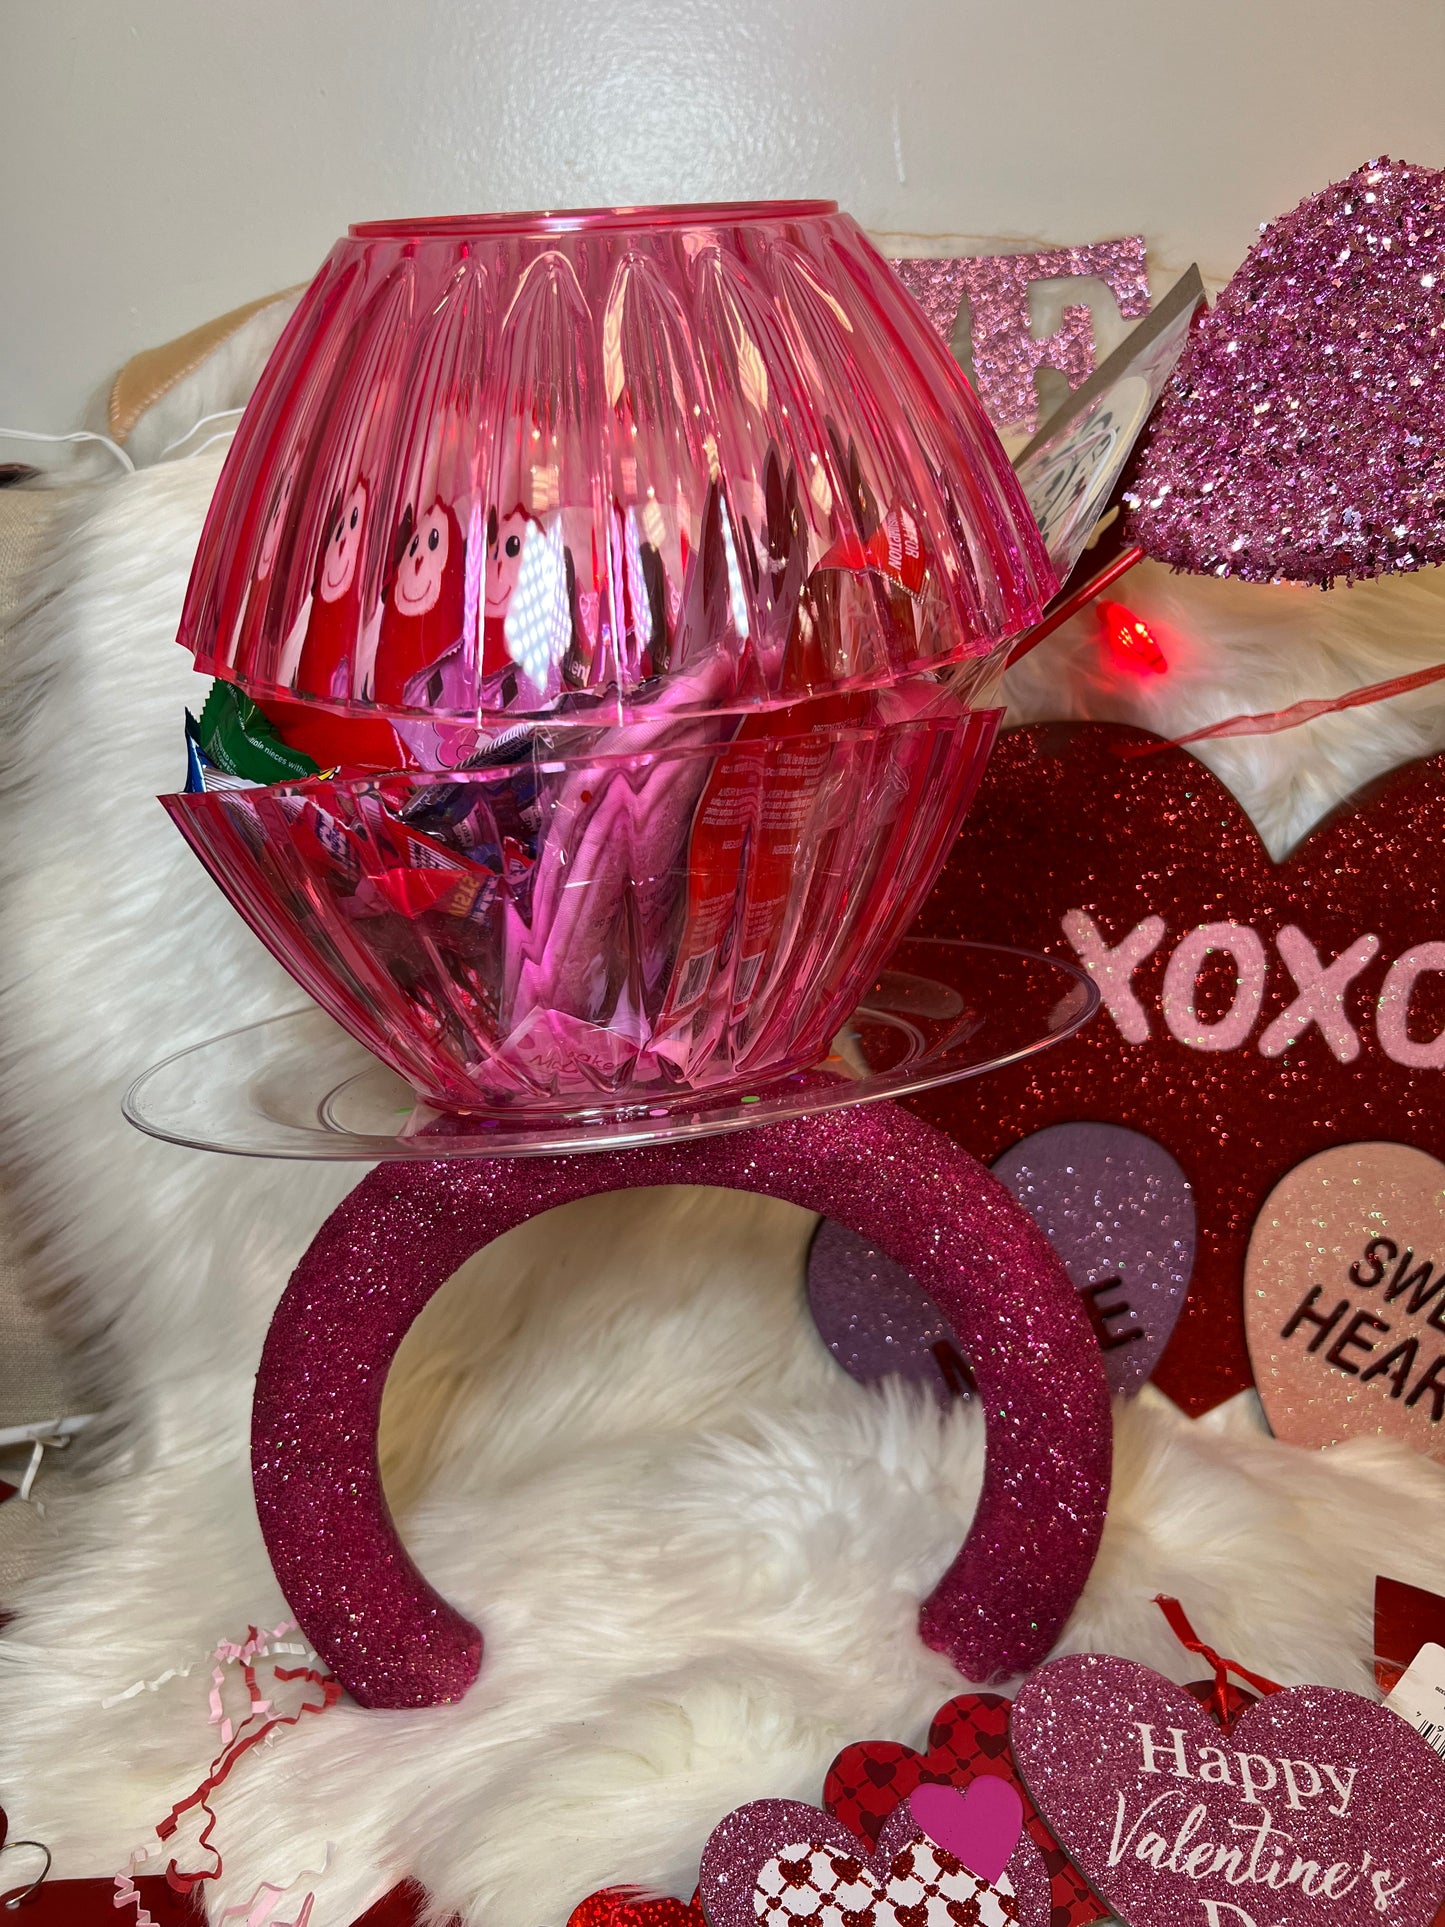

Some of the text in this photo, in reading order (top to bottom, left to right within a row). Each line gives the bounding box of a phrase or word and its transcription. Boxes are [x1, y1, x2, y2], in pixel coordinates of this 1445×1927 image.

[1060, 907, 1445, 1070] XOXO
[1134, 1721, 1358, 1817] Happy
[1105, 1789, 1406, 1912] Valentine's
